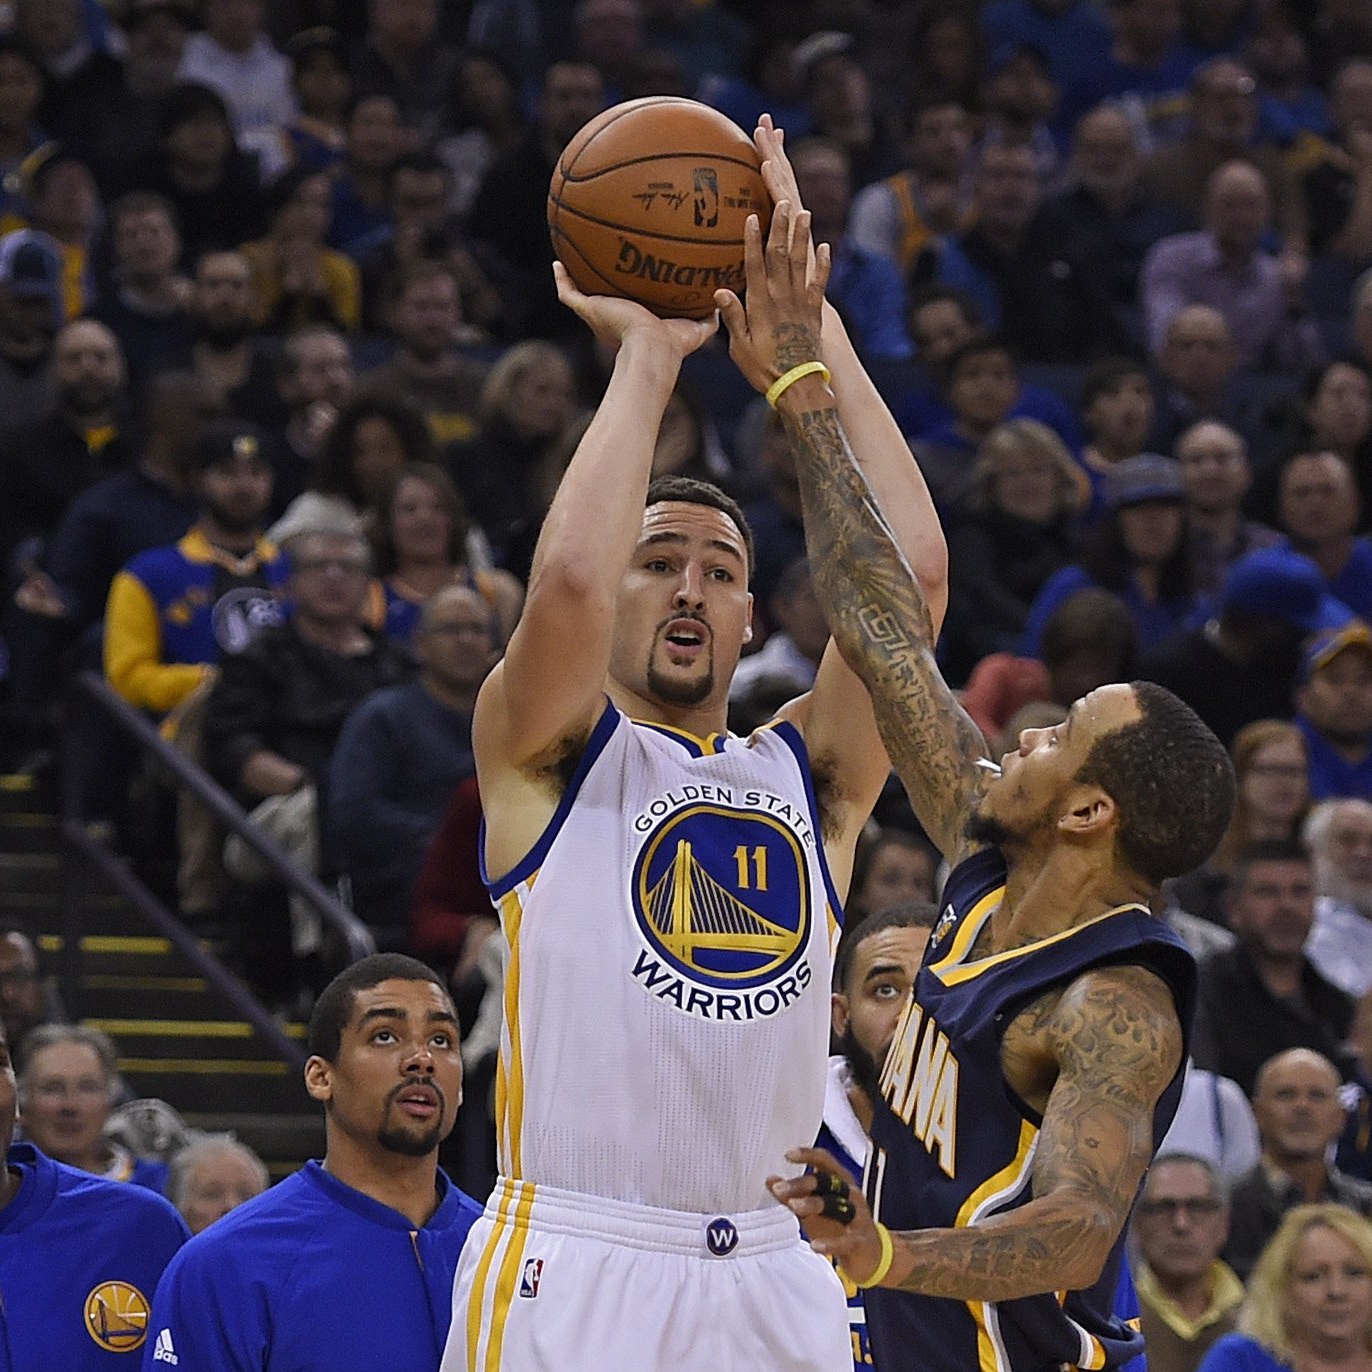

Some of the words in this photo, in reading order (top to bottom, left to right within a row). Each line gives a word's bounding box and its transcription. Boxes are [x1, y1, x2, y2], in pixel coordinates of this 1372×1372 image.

[634, 785, 732, 832] GOLDEN
[745, 792, 815, 849] STATE
[732, 845, 768, 892] 11
[631, 949, 812, 1021] WARRIORS
